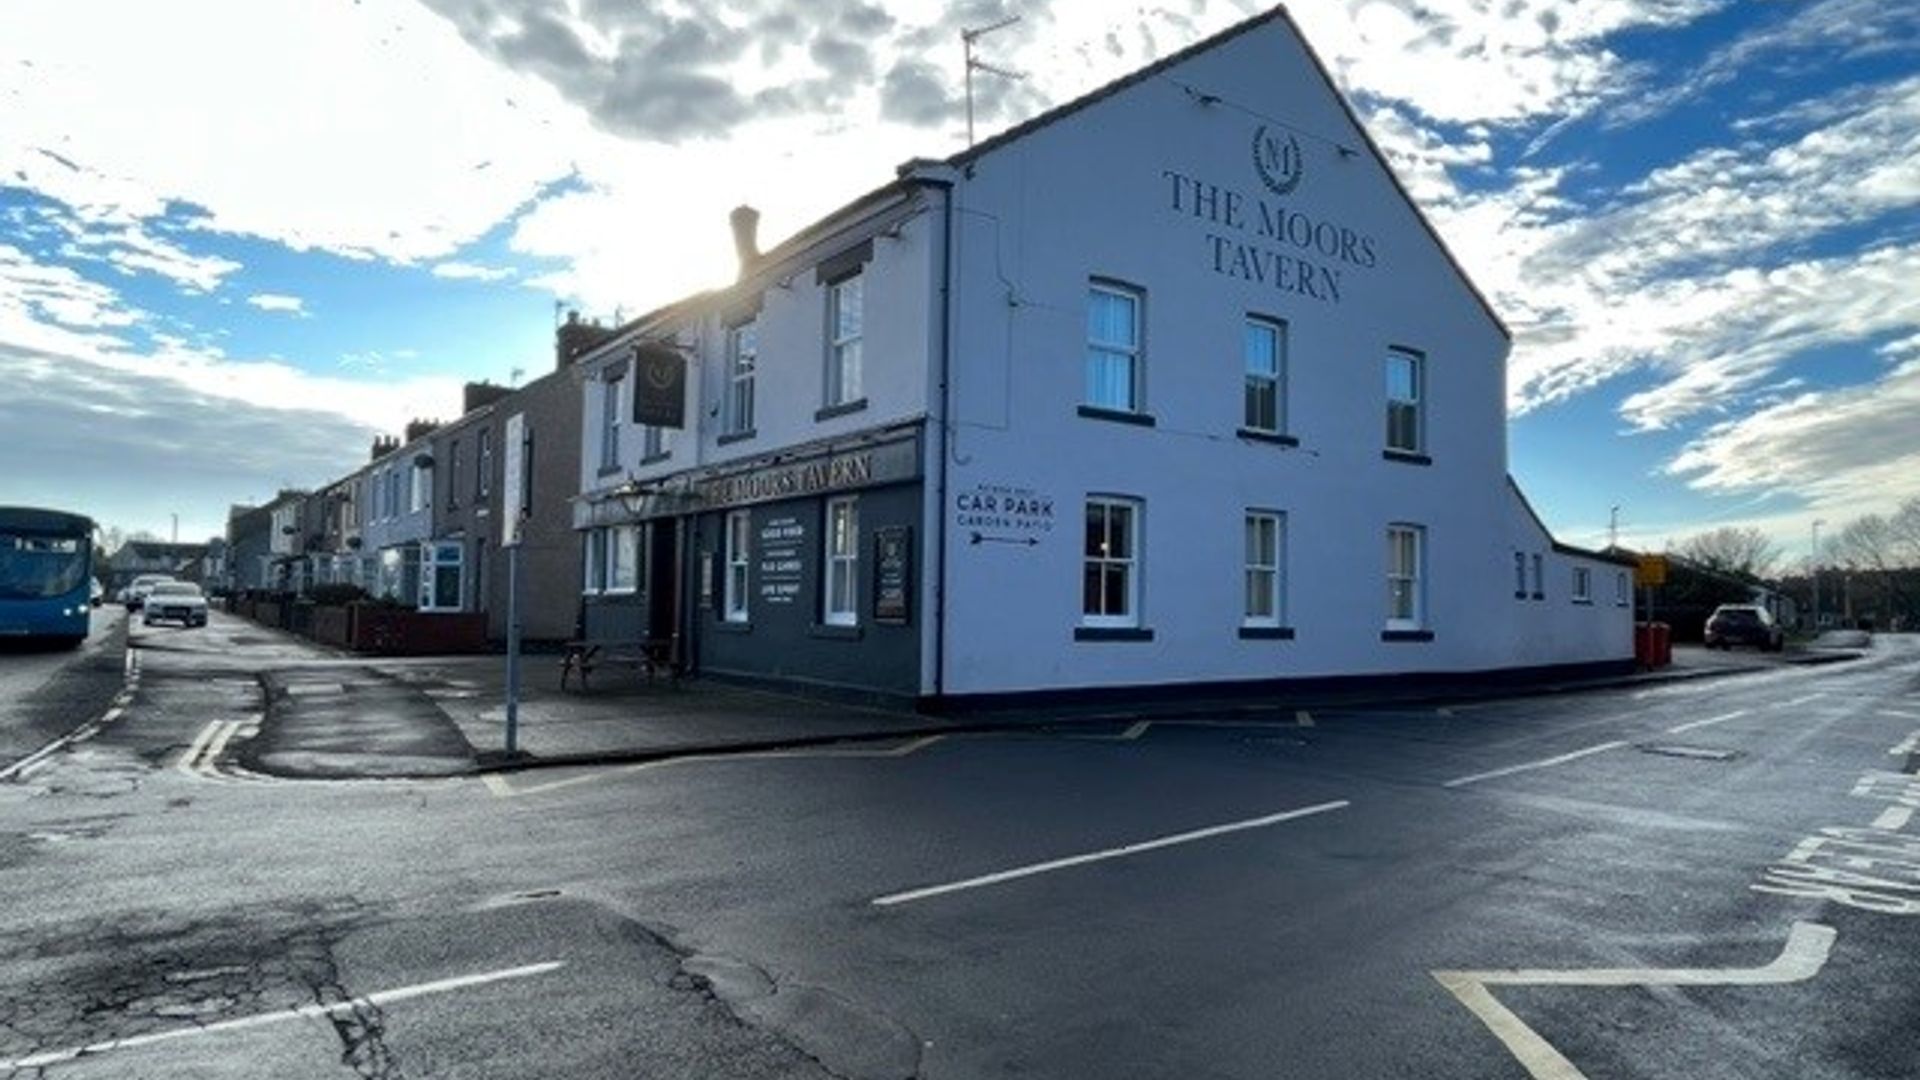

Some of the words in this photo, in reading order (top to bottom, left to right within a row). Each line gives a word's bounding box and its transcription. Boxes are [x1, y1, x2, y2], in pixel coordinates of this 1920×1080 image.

[1162, 170, 1245, 230] THE
[1257, 200, 1377, 269] MOORS
[1205, 233, 1342, 304] TAVERN
[801, 453, 872, 493] TAVERN
[957, 494, 998, 514] CAR
[1004, 498, 1056, 517] PARK
[957, 513, 1010, 529] GARDEN
